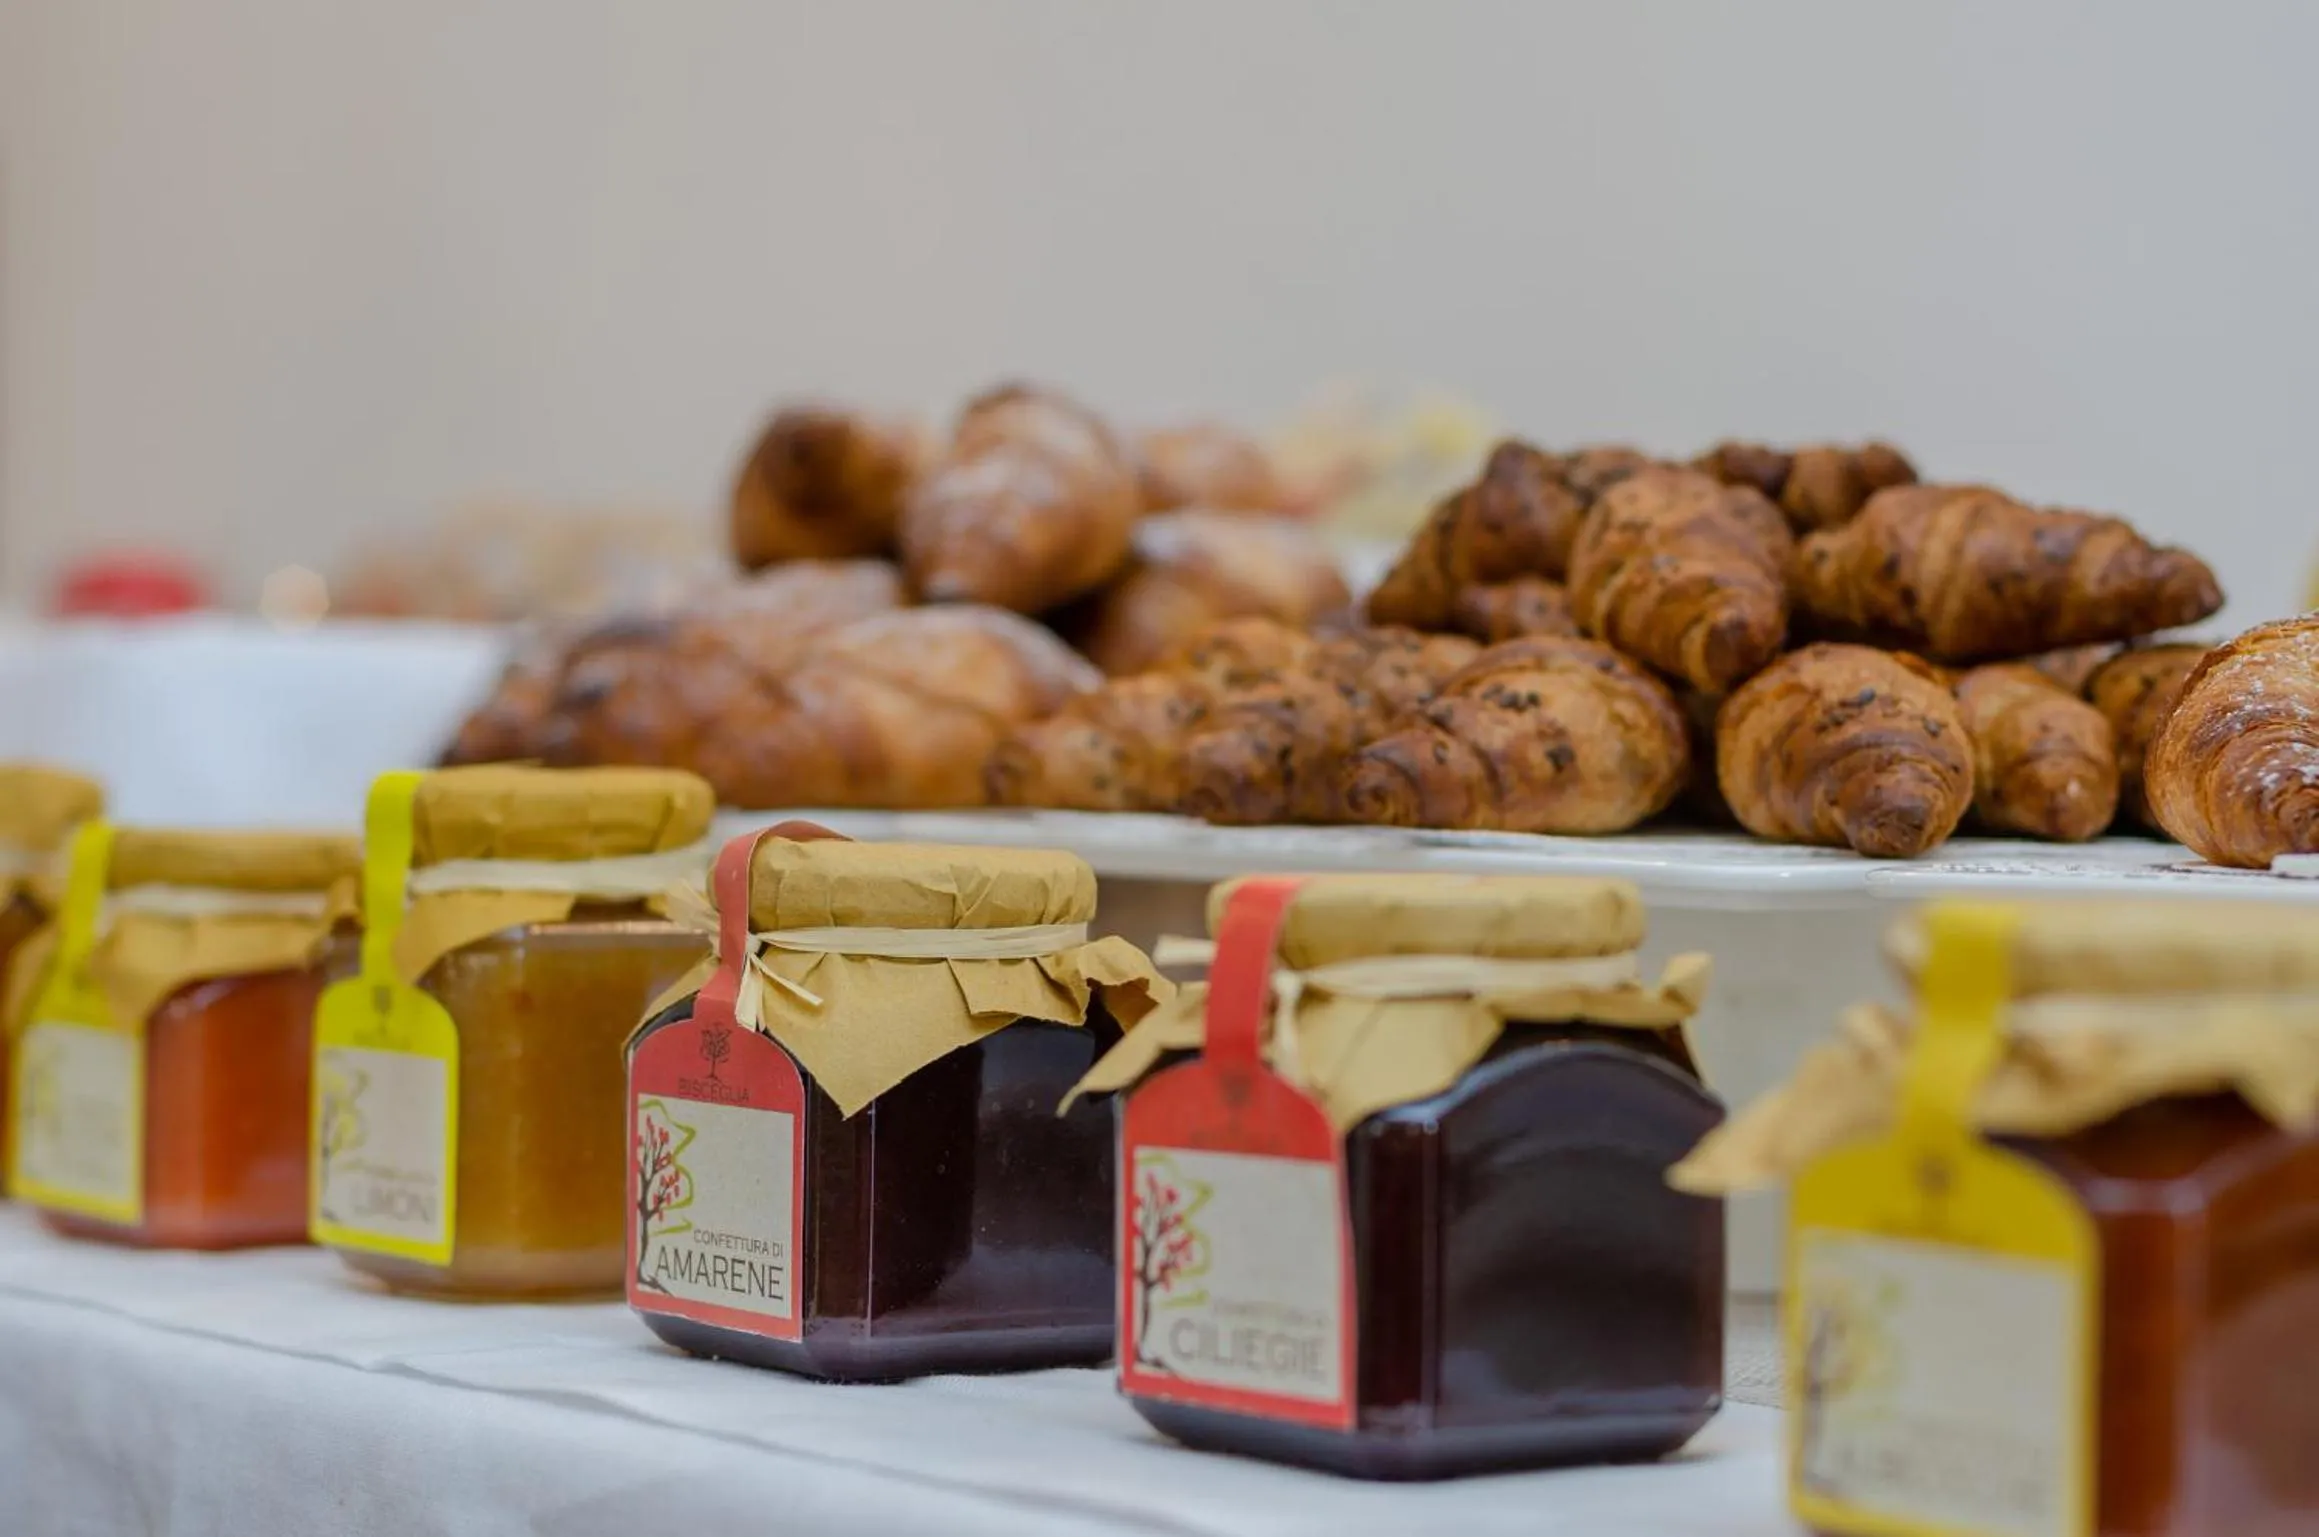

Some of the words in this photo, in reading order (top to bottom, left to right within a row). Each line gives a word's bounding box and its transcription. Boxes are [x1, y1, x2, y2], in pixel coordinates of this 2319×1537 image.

[693, 1229, 769, 1256] CONFETTURA
[772, 1241, 783, 1258] DI
[655, 1244, 784, 1300] AMARENE
